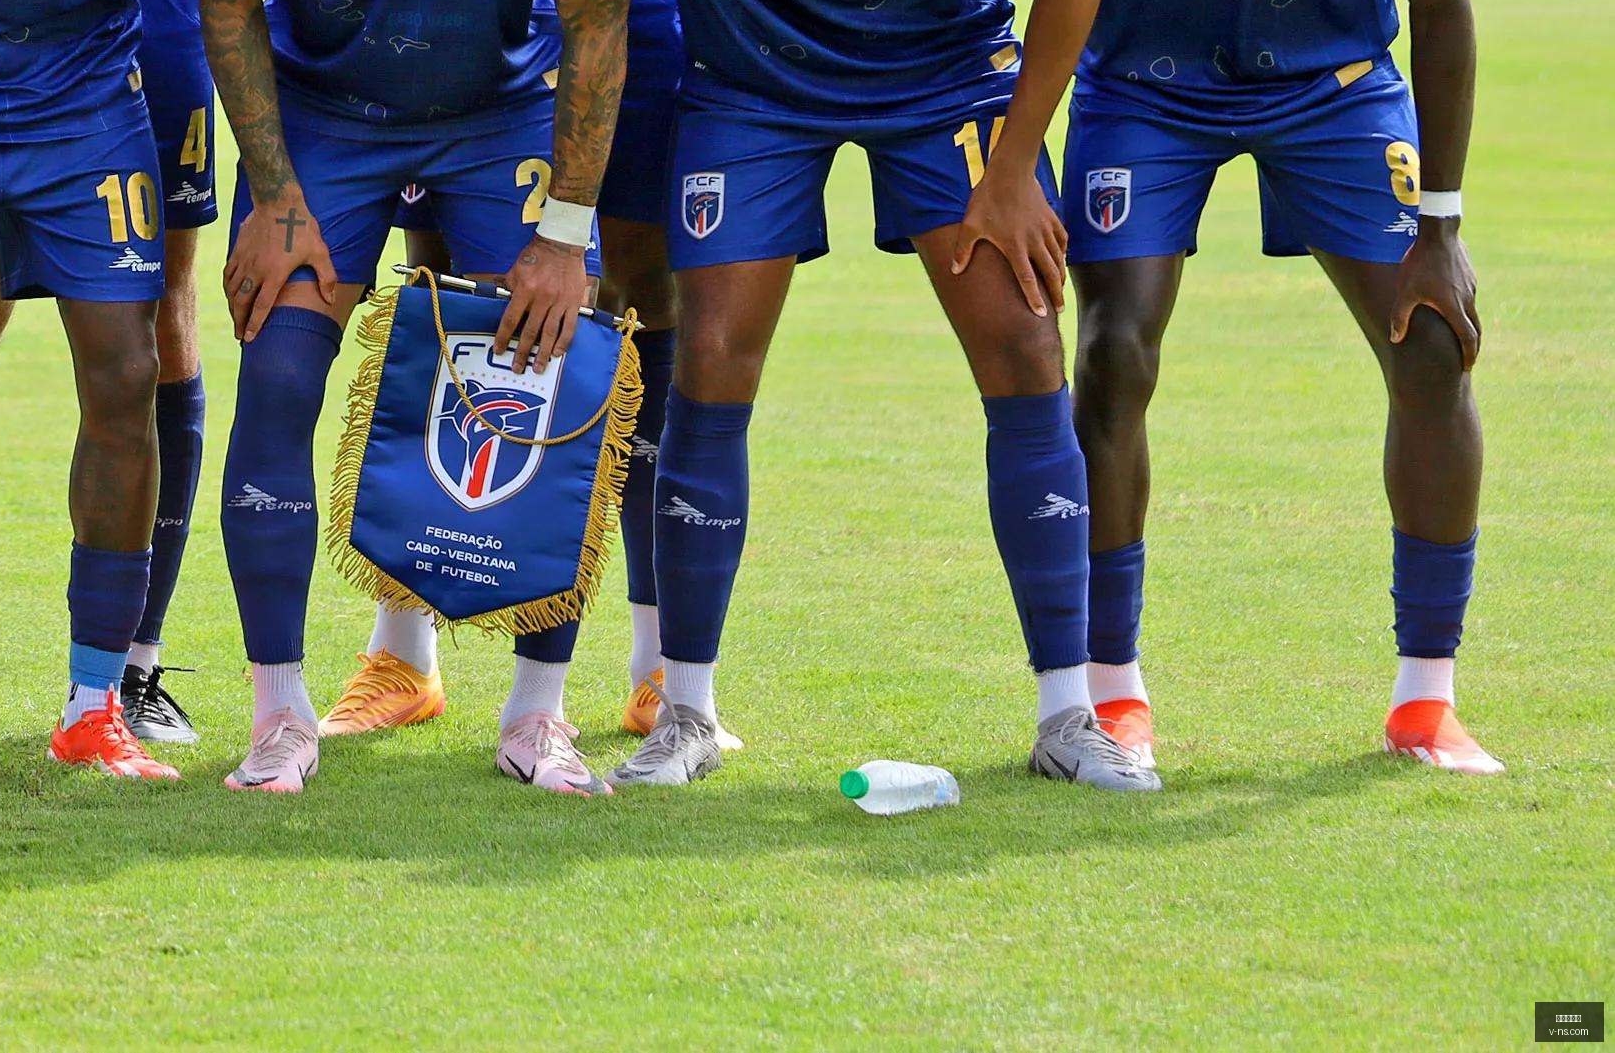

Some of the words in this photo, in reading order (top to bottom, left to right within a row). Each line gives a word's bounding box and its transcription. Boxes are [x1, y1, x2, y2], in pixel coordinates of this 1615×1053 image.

[180, 106, 208, 174] 4
[954, 116, 1006, 189] 1
[686, 176, 720, 189] FCF
[1088, 171, 1127, 184] FCF
[1386, 140, 1420, 197] 8
[96, 171, 158, 244] 10
[254, 500, 313, 514] tempo
[683, 514, 742, 530] tempo
[425, 526, 503, 551] FEDERAÇÃO
[405, 541, 517, 572] CABO-VERDIANA
[415, 559, 434, 573] DE
[441, 566, 501, 587] FUTEBOL
